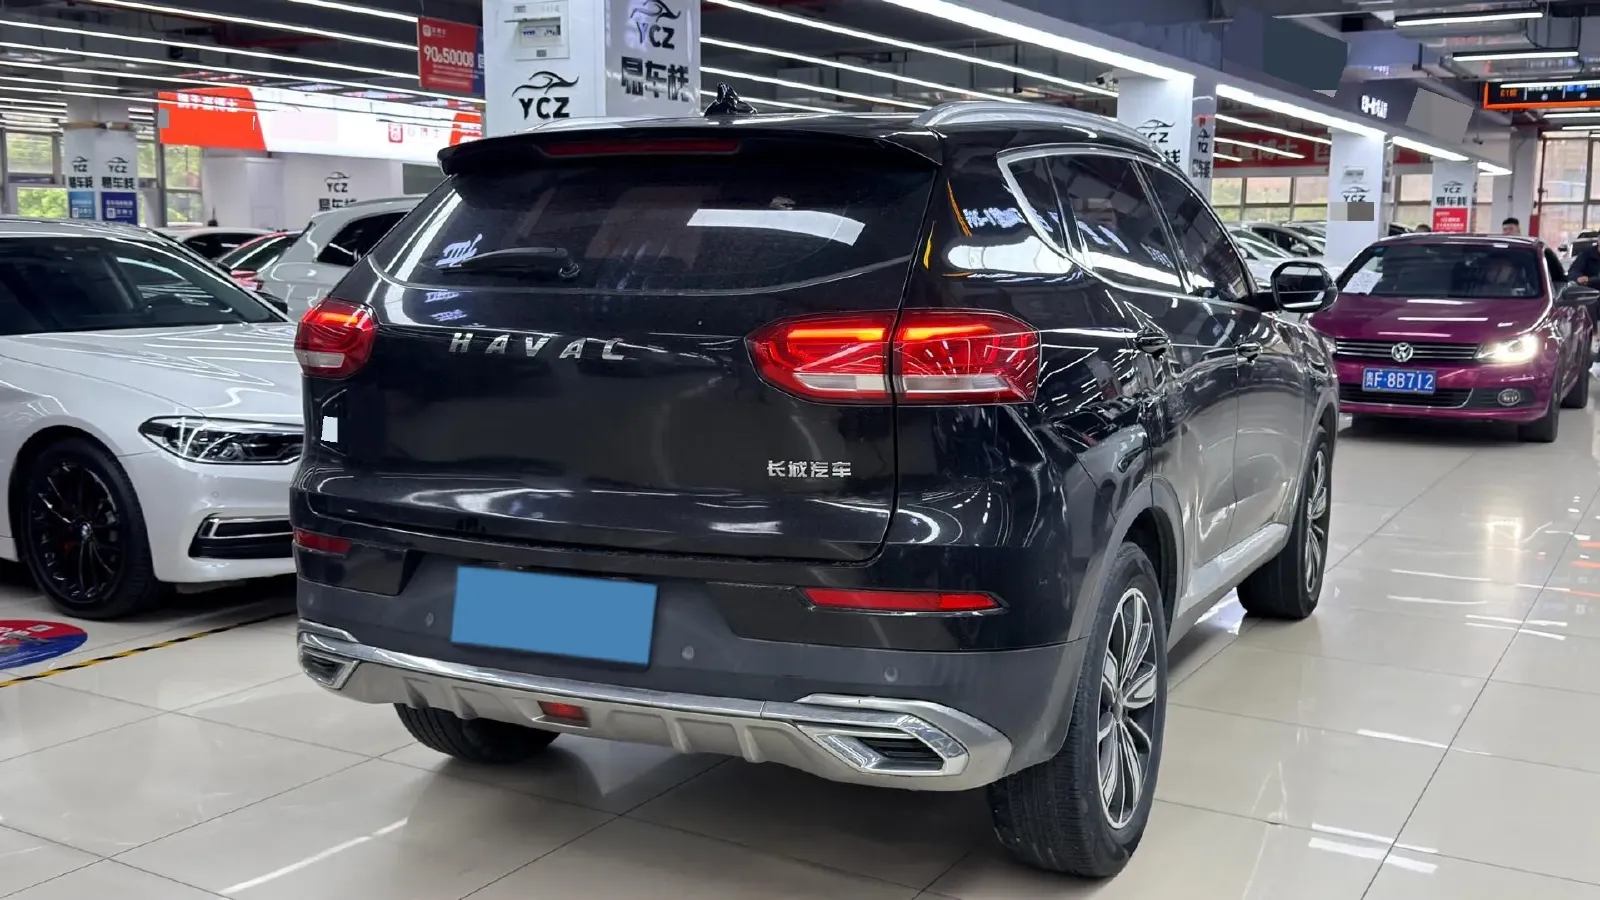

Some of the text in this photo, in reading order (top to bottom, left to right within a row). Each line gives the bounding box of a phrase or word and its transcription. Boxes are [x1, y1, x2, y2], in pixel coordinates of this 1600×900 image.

[636, 22, 675, 50] YCZ
[518, 97, 571, 120] YCZ
[1143, 132, 1169, 144] CZ
[73, 164, 88, 173] YCZ
[108, 165, 128, 173] YCZ
[326, 182, 349, 193] YCZ
[1343, 194, 1366, 203] YCZ
[448, 332, 625, 361] HAVAL
[767, 460, 852, 478] 长城汽车
